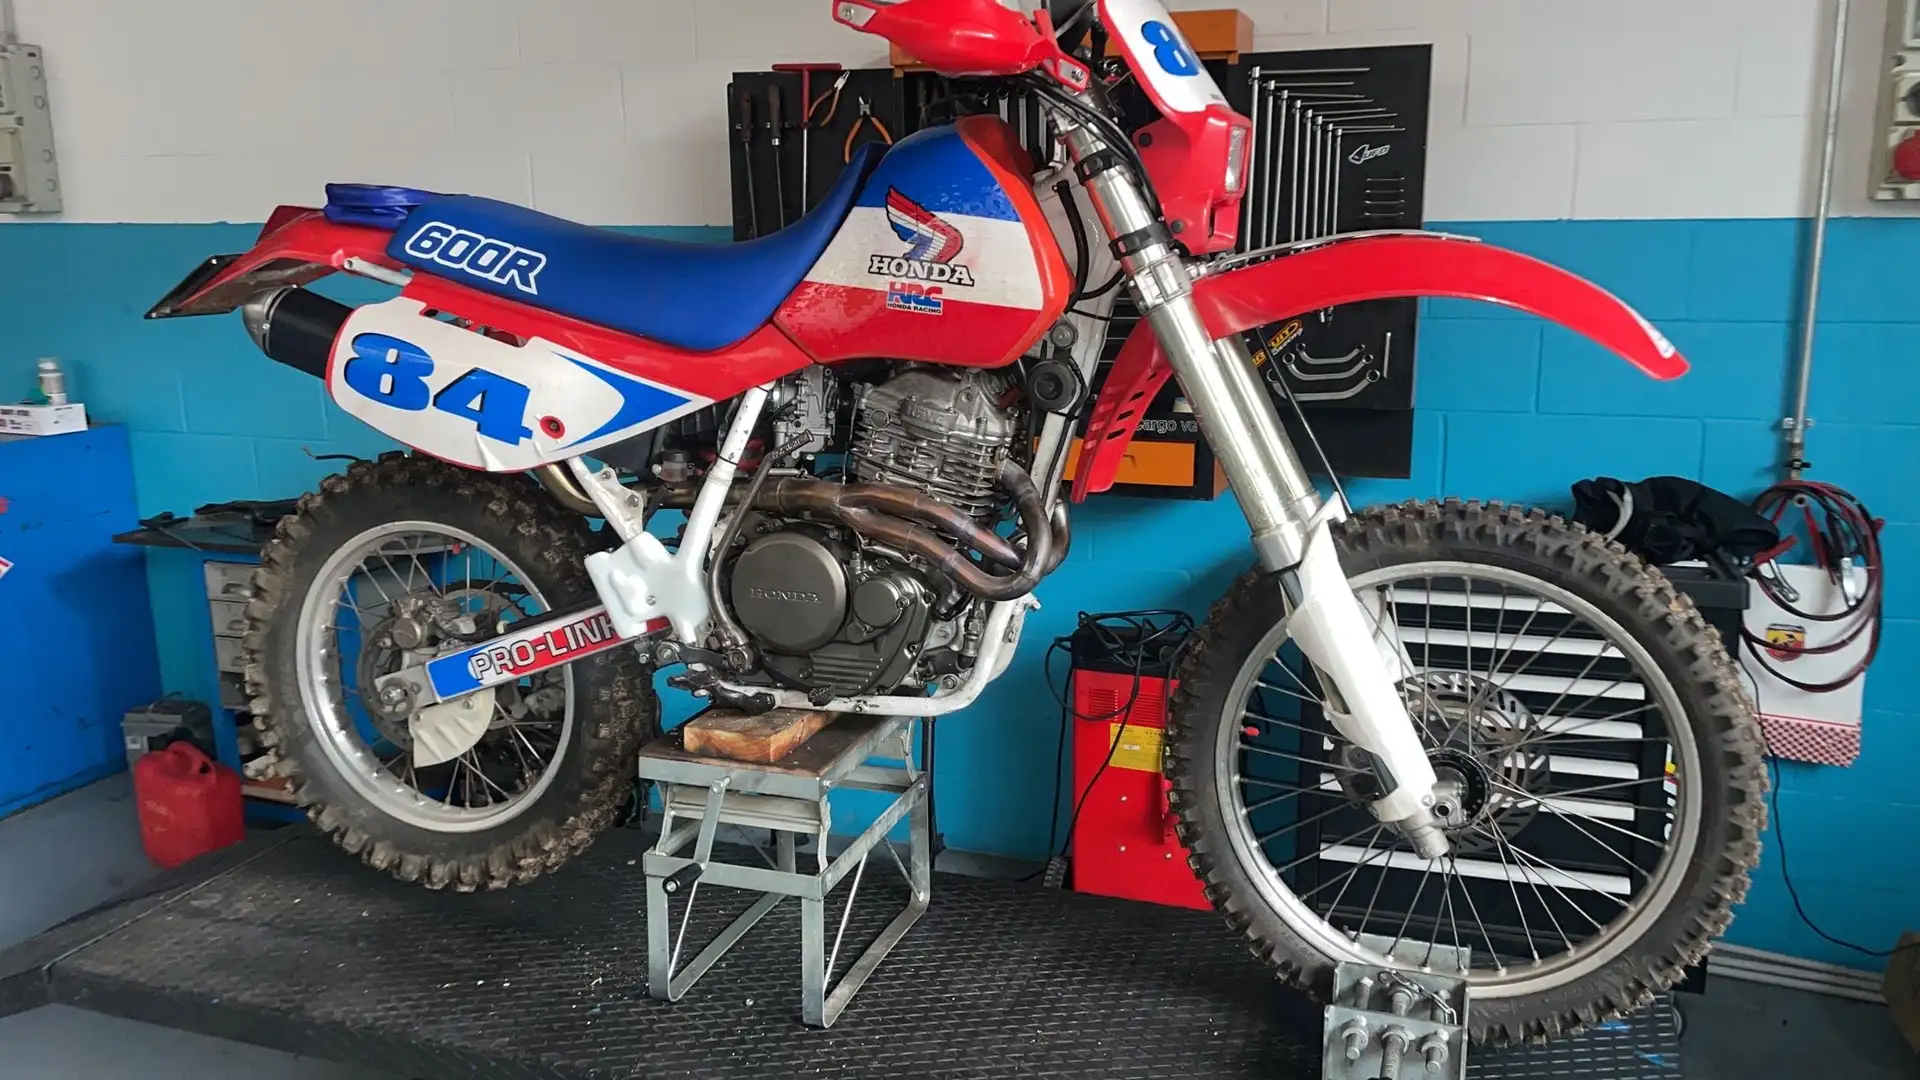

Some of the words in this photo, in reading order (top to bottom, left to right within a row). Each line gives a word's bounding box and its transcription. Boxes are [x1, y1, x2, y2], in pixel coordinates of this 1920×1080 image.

[1141, 20, 1199, 76] 8
[405, 221, 547, 295] 600R
[868, 254, 975, 287] HONDA
[887, 302, 912, 311] HONDA
[913, 304, 942, 314] RACING
[888, 280, 943, 308] HRC
[344, 332, 533, 446] 84
[749, 587, 822, 604] HONDA
